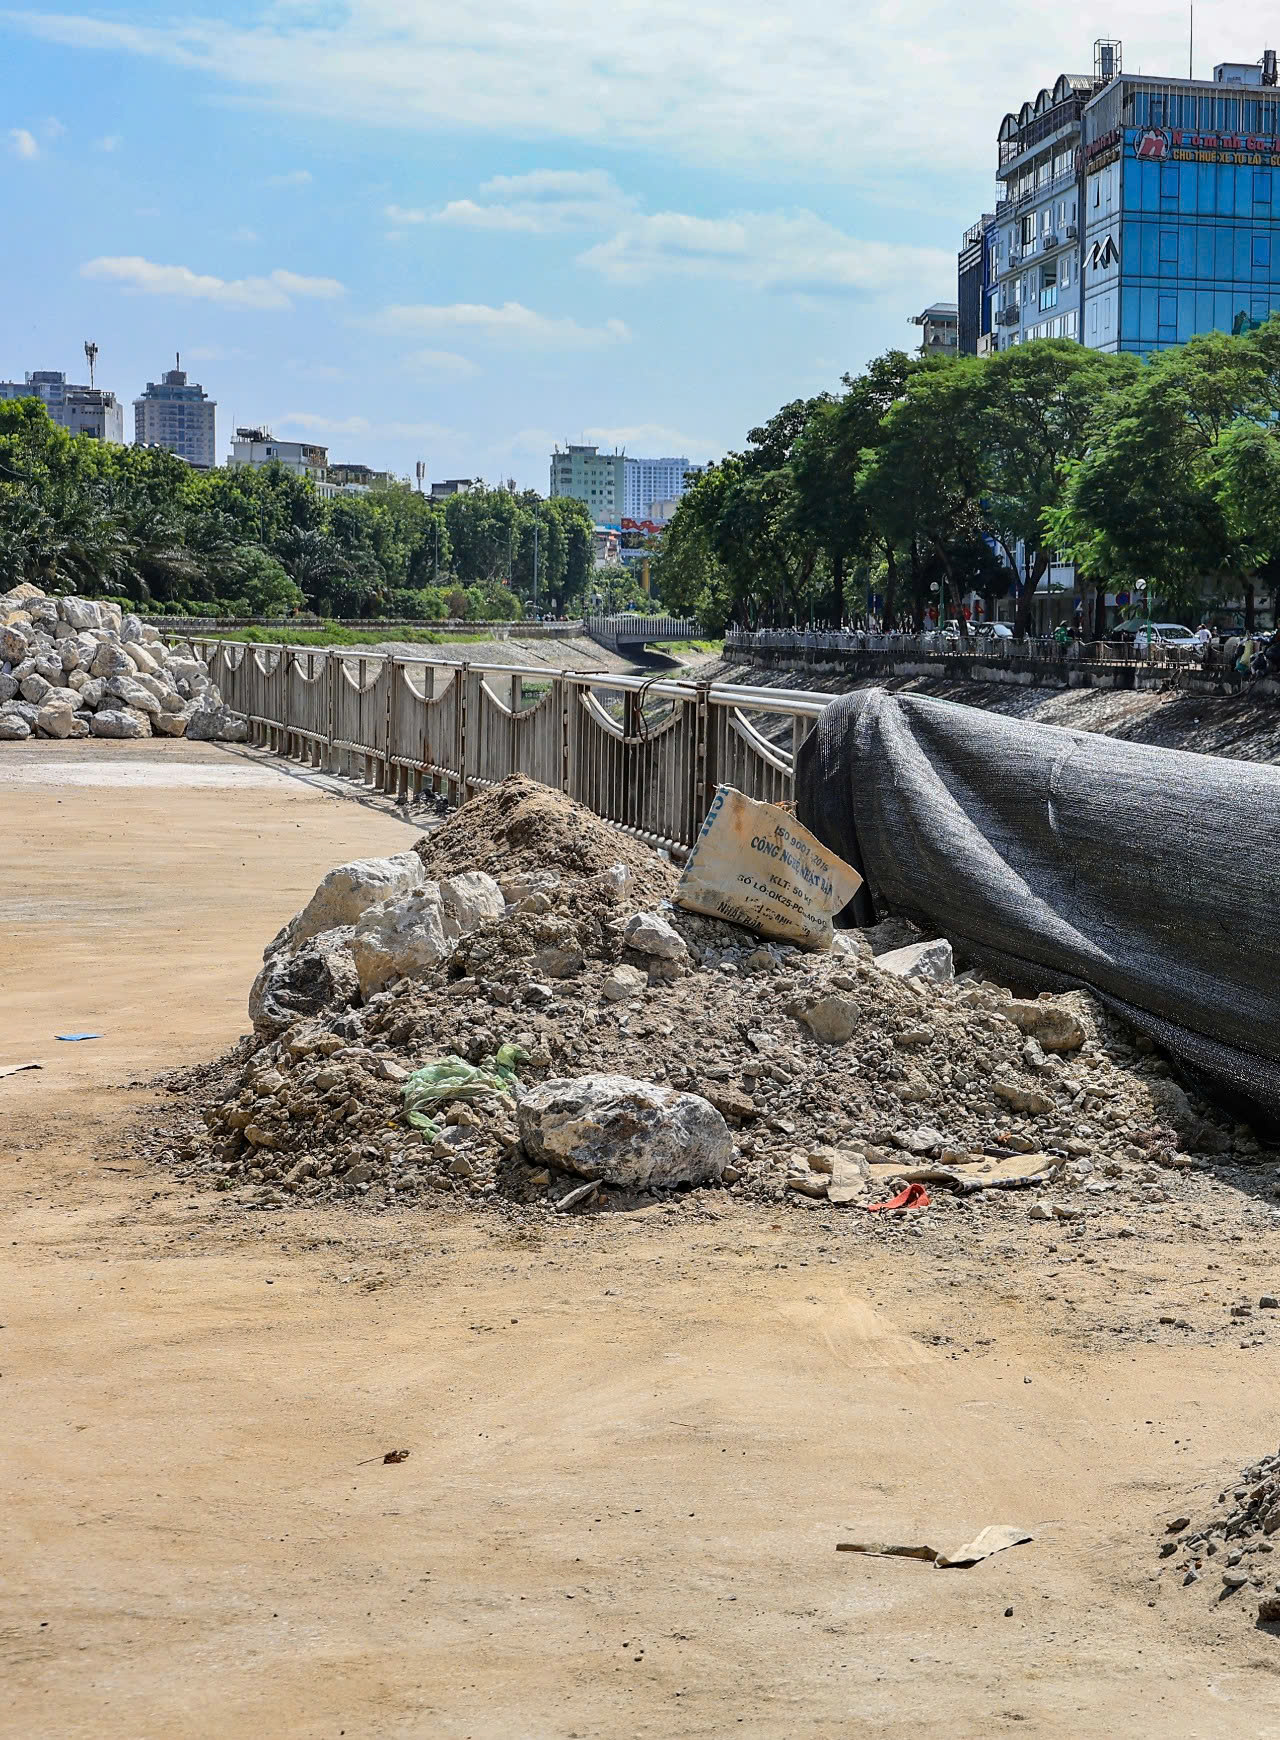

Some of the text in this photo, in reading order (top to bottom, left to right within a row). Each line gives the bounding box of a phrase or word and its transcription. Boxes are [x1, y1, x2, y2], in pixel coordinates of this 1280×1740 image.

[1173, 150, 1192, 160] CHO
[774, 825, 790, 840] ISO
[750, 835, 780, 858] CÔNG
[737, 874, 754, 885] SỐ
[770, 874, 791, 891] KLT:
[792, 887, 803, 898] 50
